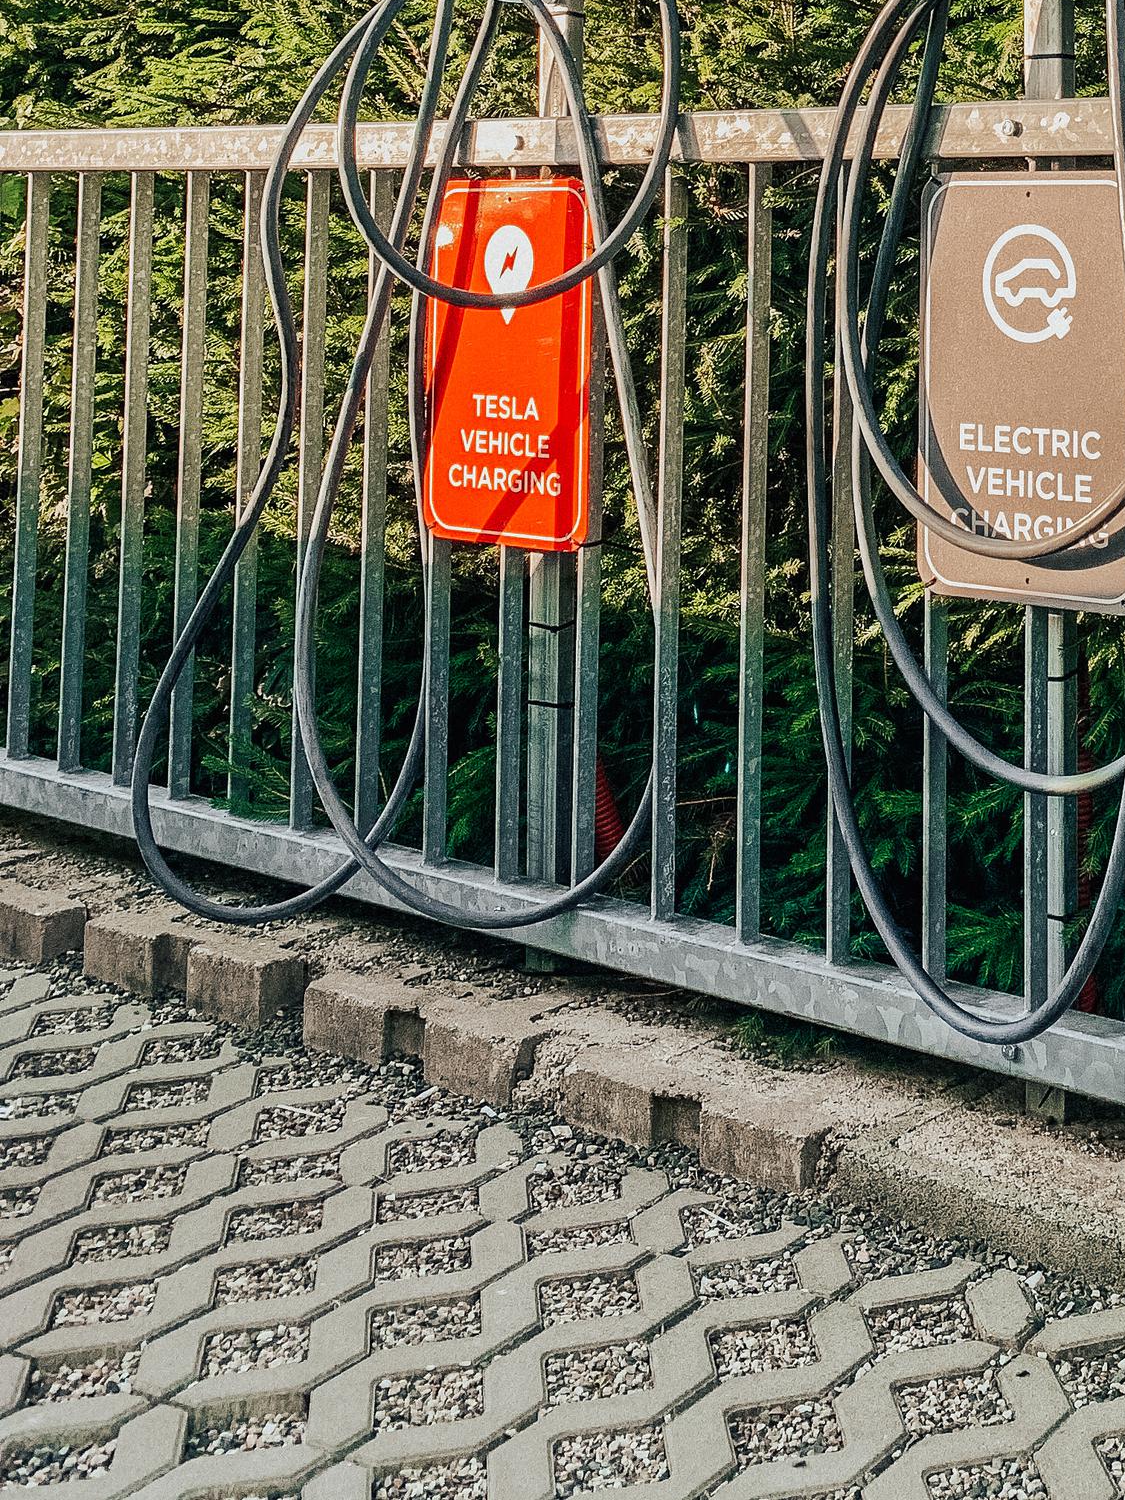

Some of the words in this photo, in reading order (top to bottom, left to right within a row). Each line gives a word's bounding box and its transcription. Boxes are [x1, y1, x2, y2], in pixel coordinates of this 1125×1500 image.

[472, 393, 540, 421] TESLA
[460, 428, 550, 459] VEHICLE
[959, 423, 1102, 460] ELECTRIC
[448, 463, 561, 497] CHARGING
[966, 466, 1093, 504] VEHICLE
